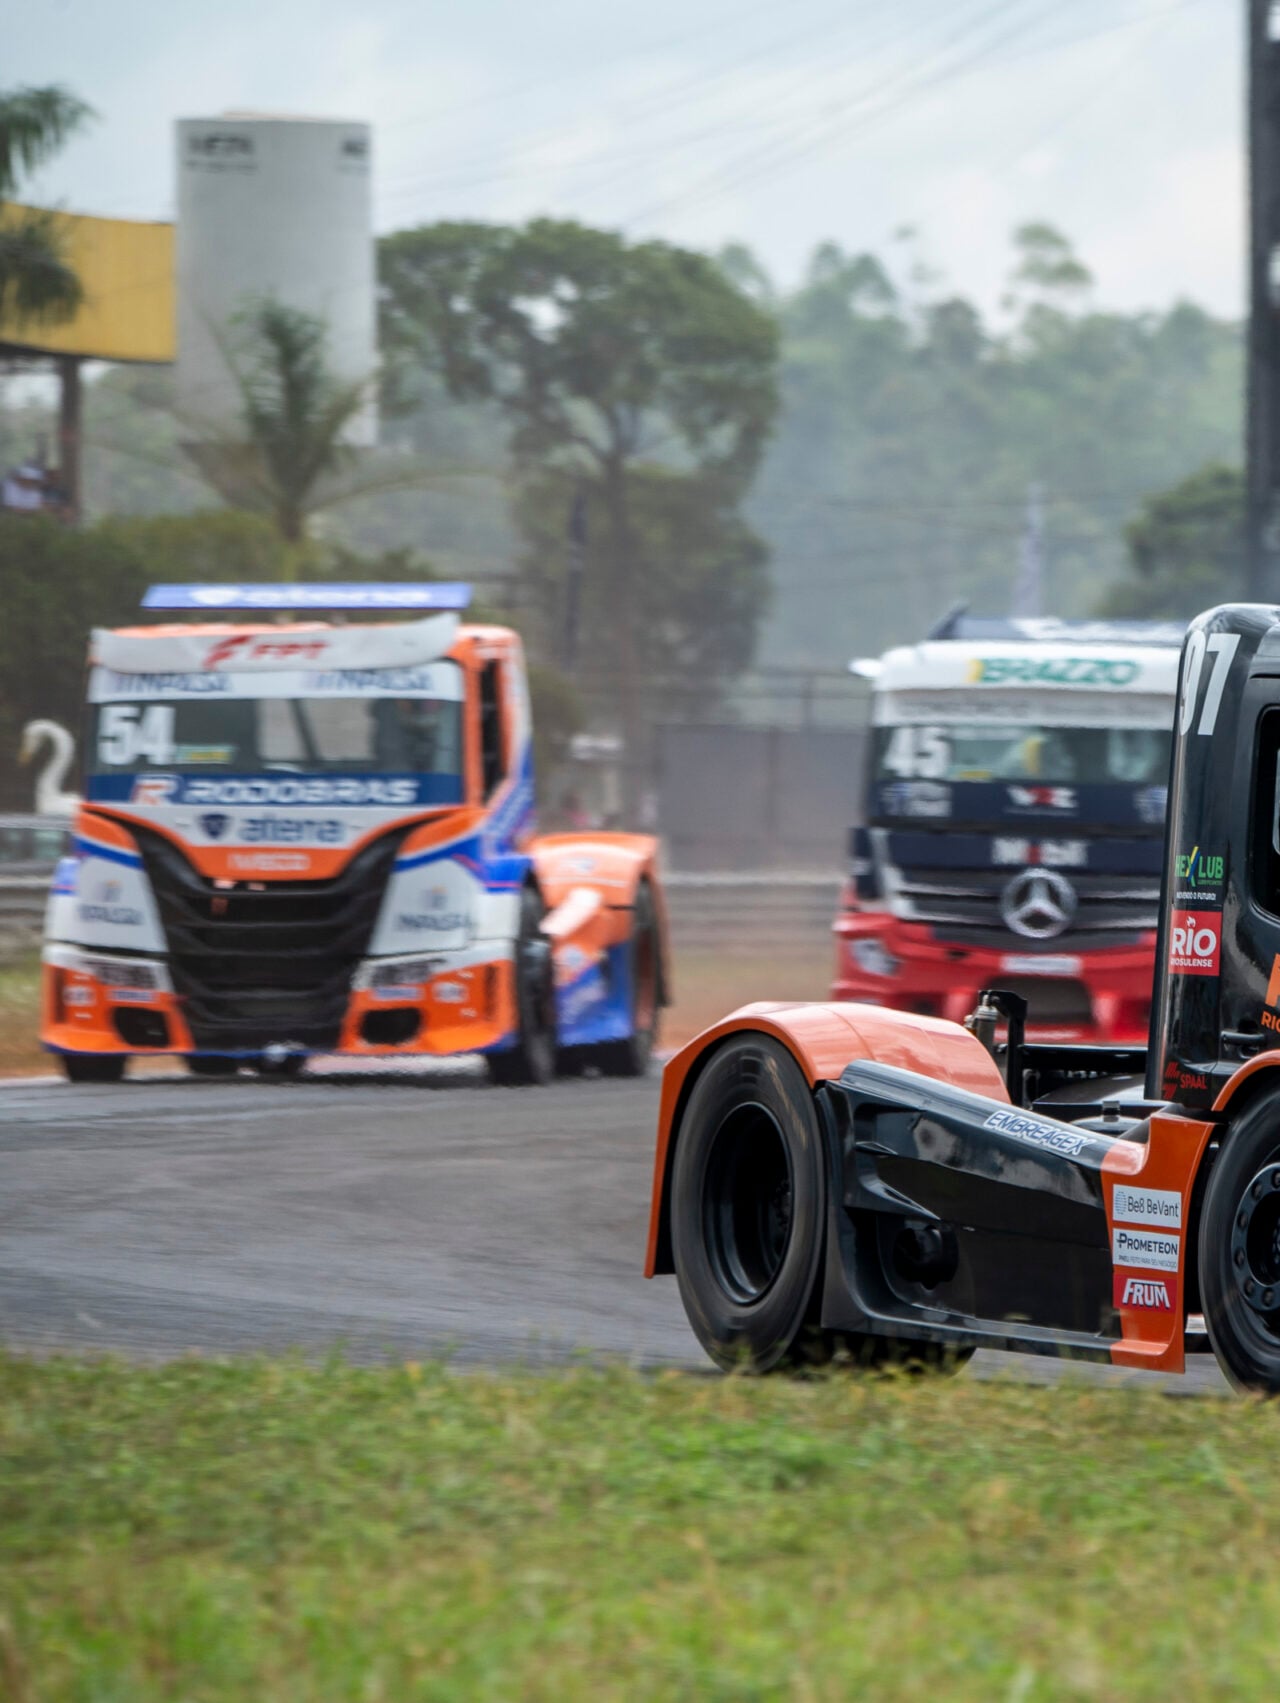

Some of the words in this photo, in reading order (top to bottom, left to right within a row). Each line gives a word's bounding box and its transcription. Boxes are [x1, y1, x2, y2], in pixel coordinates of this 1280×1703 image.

[249, 638, 331, 660] FPT
[982, 657, 1142, 685] BRAZZO
[1179, 630, 1242, 736] 97
[100, 703, 176, 766] 54
[883, 726, 949, 779] 45
[181, 777, 421, 804] RODOBRAS
[237, 813, 346, 843] atena
[1171, 917, 1217, 957] RIO
[1180, 1073, 1208, 1090] SPAAL
[985, 1111, 1092, 1154] EMBREAGEX
[1127, 1195, 1145, 1214] Be8
[1146, 1198, 1179, 1218] BeVant
[1117, 1232, 1178, 1255] PROMETEON
[1122, 1278, 1171, 1309] FRUM
